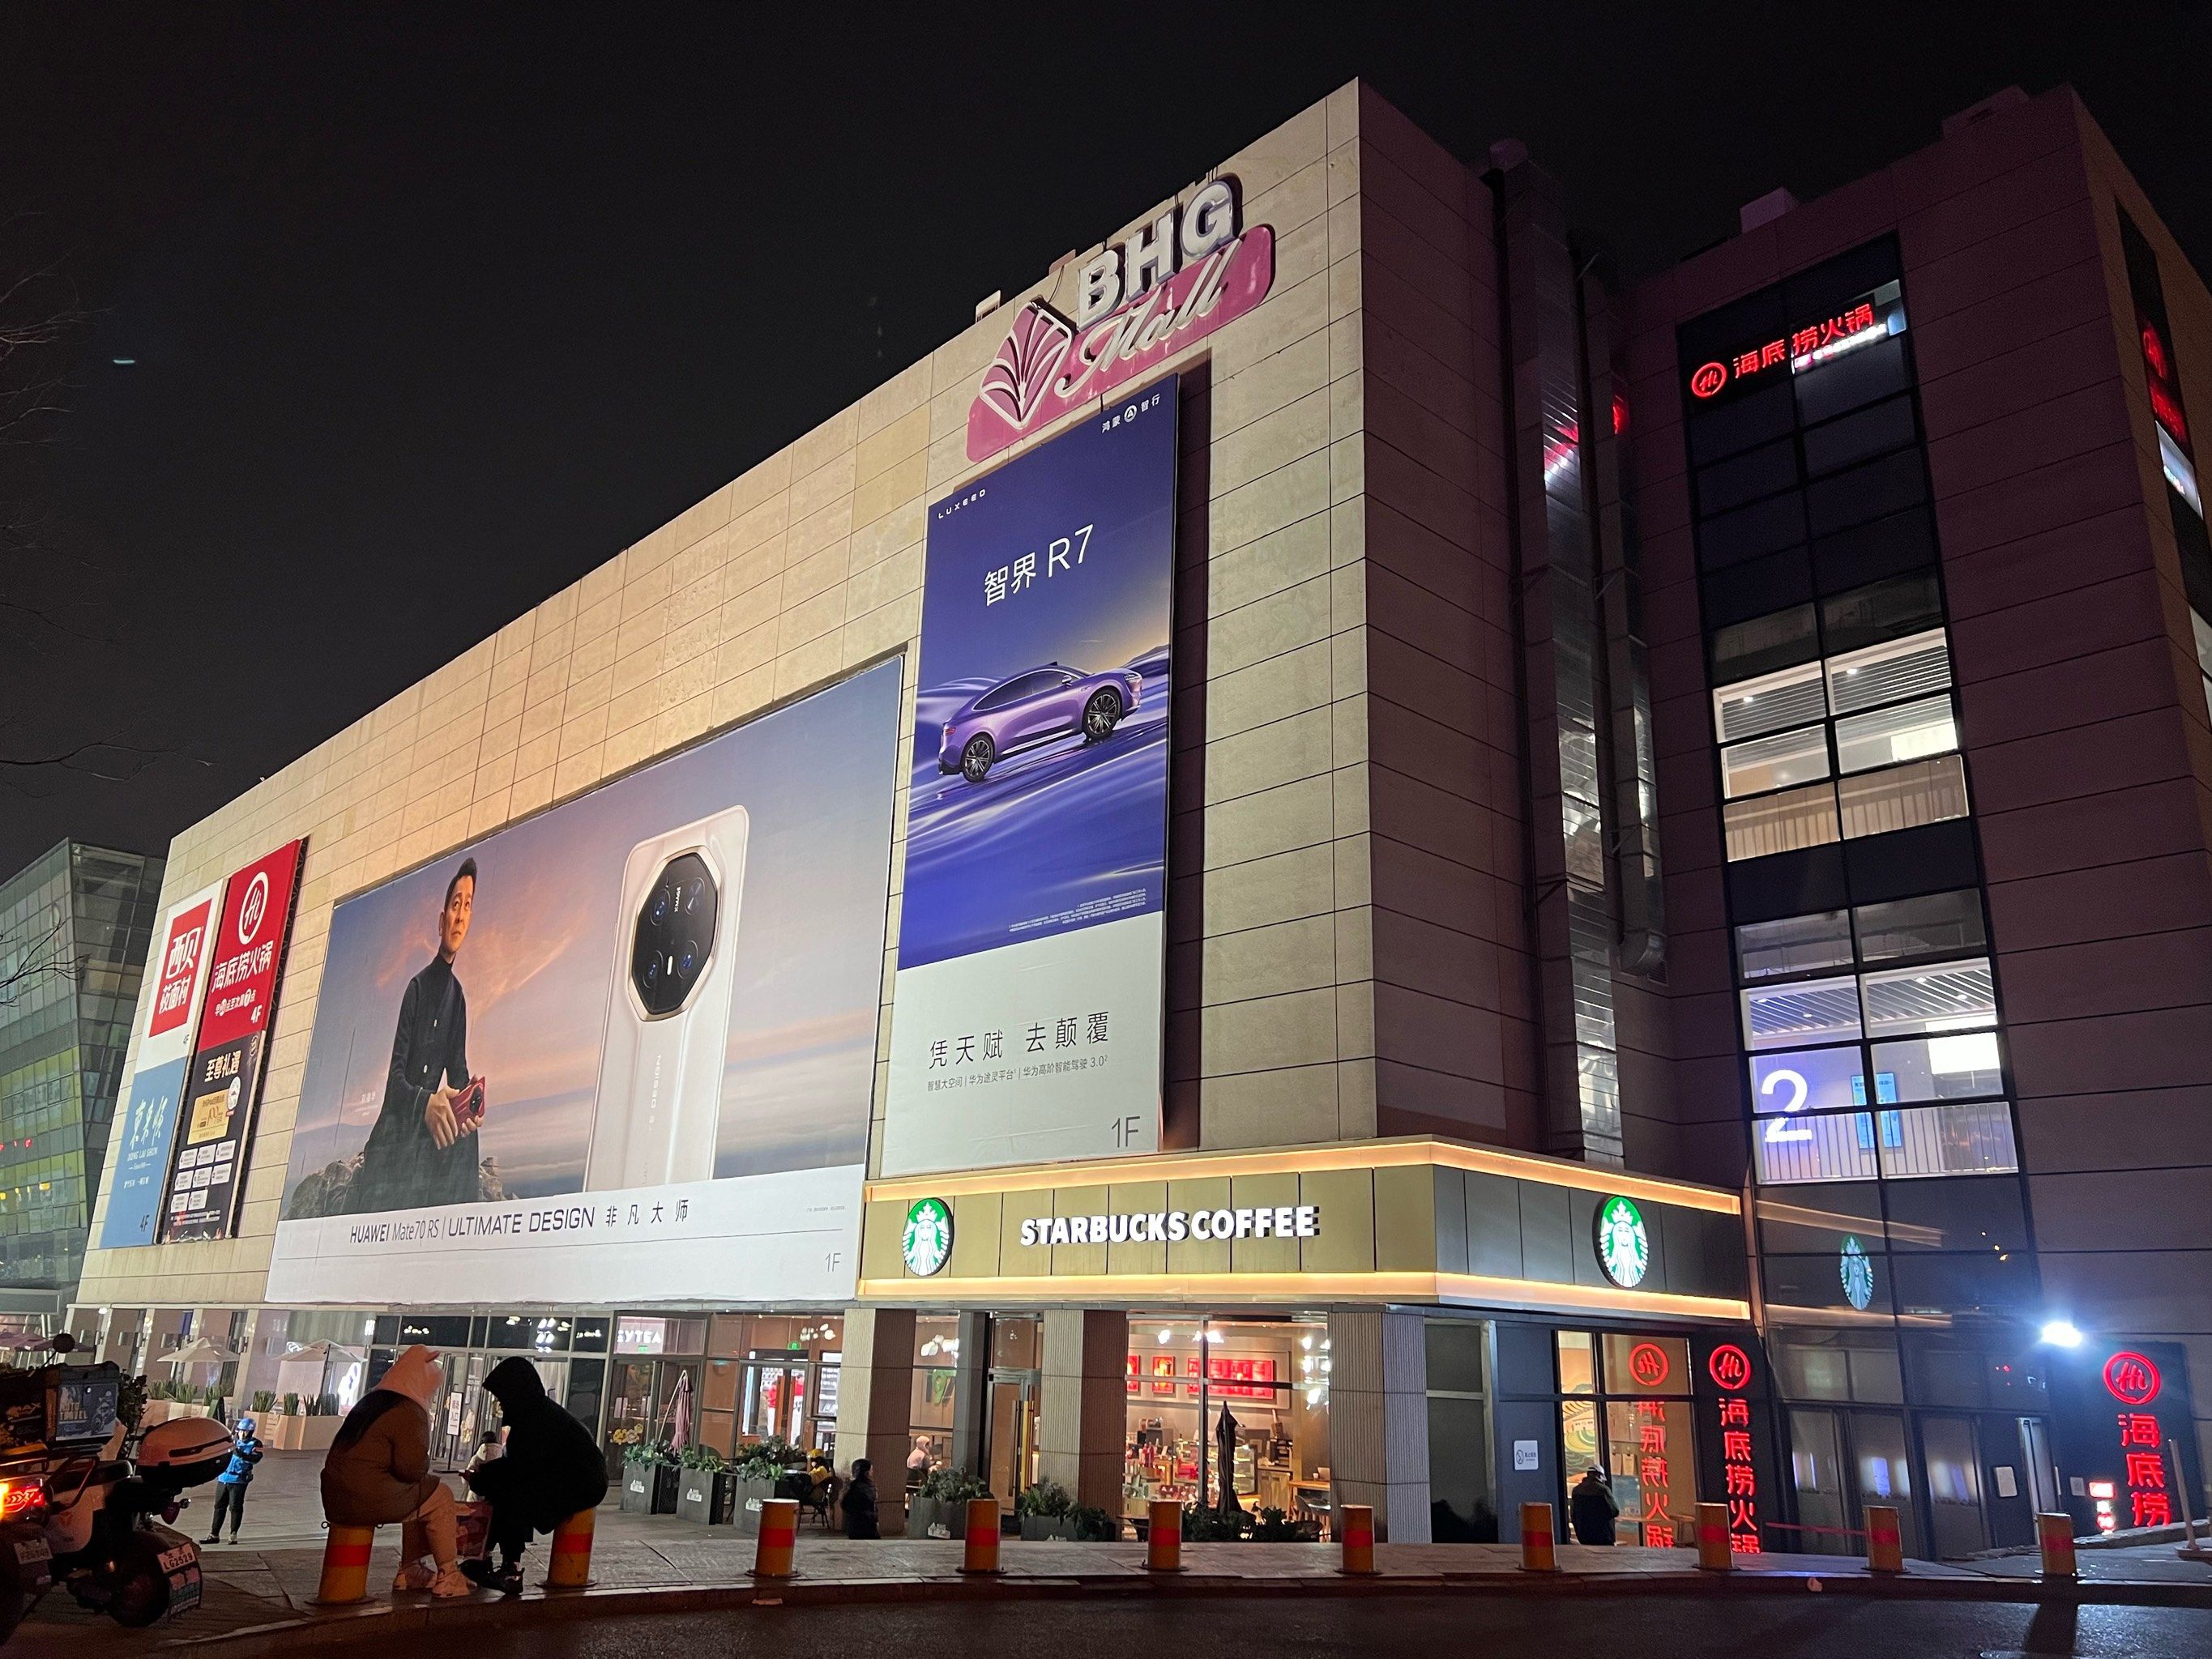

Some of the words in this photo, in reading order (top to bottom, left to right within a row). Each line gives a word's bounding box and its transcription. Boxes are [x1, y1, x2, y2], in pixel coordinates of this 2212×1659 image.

[1078, 176, 1239, 332] BHG
[1733, 303, 1874, 378] 海底捞火锅
[1102, 417, 1121, 433] 鸿蒙
[1141, 394, 1160, 412] 智行
[937, 488, 986, 518] LUXEED
[984, 552, 1036, 606] 智界
[1048, 523, 1093, 578] R7
[211, 940, 274, 993] 海底捞火锅
[250, 1004, 263, 1024] 4F
[929, 1030, 1003, 1069] 凭天赋
[1025, 1012, 1109, 1053] 去颠覆
[204, 1050, 241, 1082] 至尊礼遇
[650, 1054, 662, 1109] DESIGN
[928, 1076, 963, 1091] 智慧大空间
[1023, 1058, 1087, 1076] 华为高阶智能驾驶
[1761, 1069, 1813, 1143] 2
[1111, 1115, 1141, 1149] 1F
[139, 1215, 150, 1232] 4F
[350, 1224, 389, 1243] HUAWEI
[392, 1220, 425, 1241] Mate70
[428, 1219, 439, 1238] RS
[449, 1213, 523, 1237] ULTIMATE
[528, 1207, 595, 1232] DESIGN
[605, 1199, 689, 1227] 非凡大师
[1021, 1212, 1187, 1246] STARBUCKS
[1191, 1206, 1318, 1241] COFFEE
[825, 1252, 842, 1273] 1F
[1718, 1398, 1761, 1554] 海底捞火锅
[2118, 1413, 2172, 1527] 海底捞
